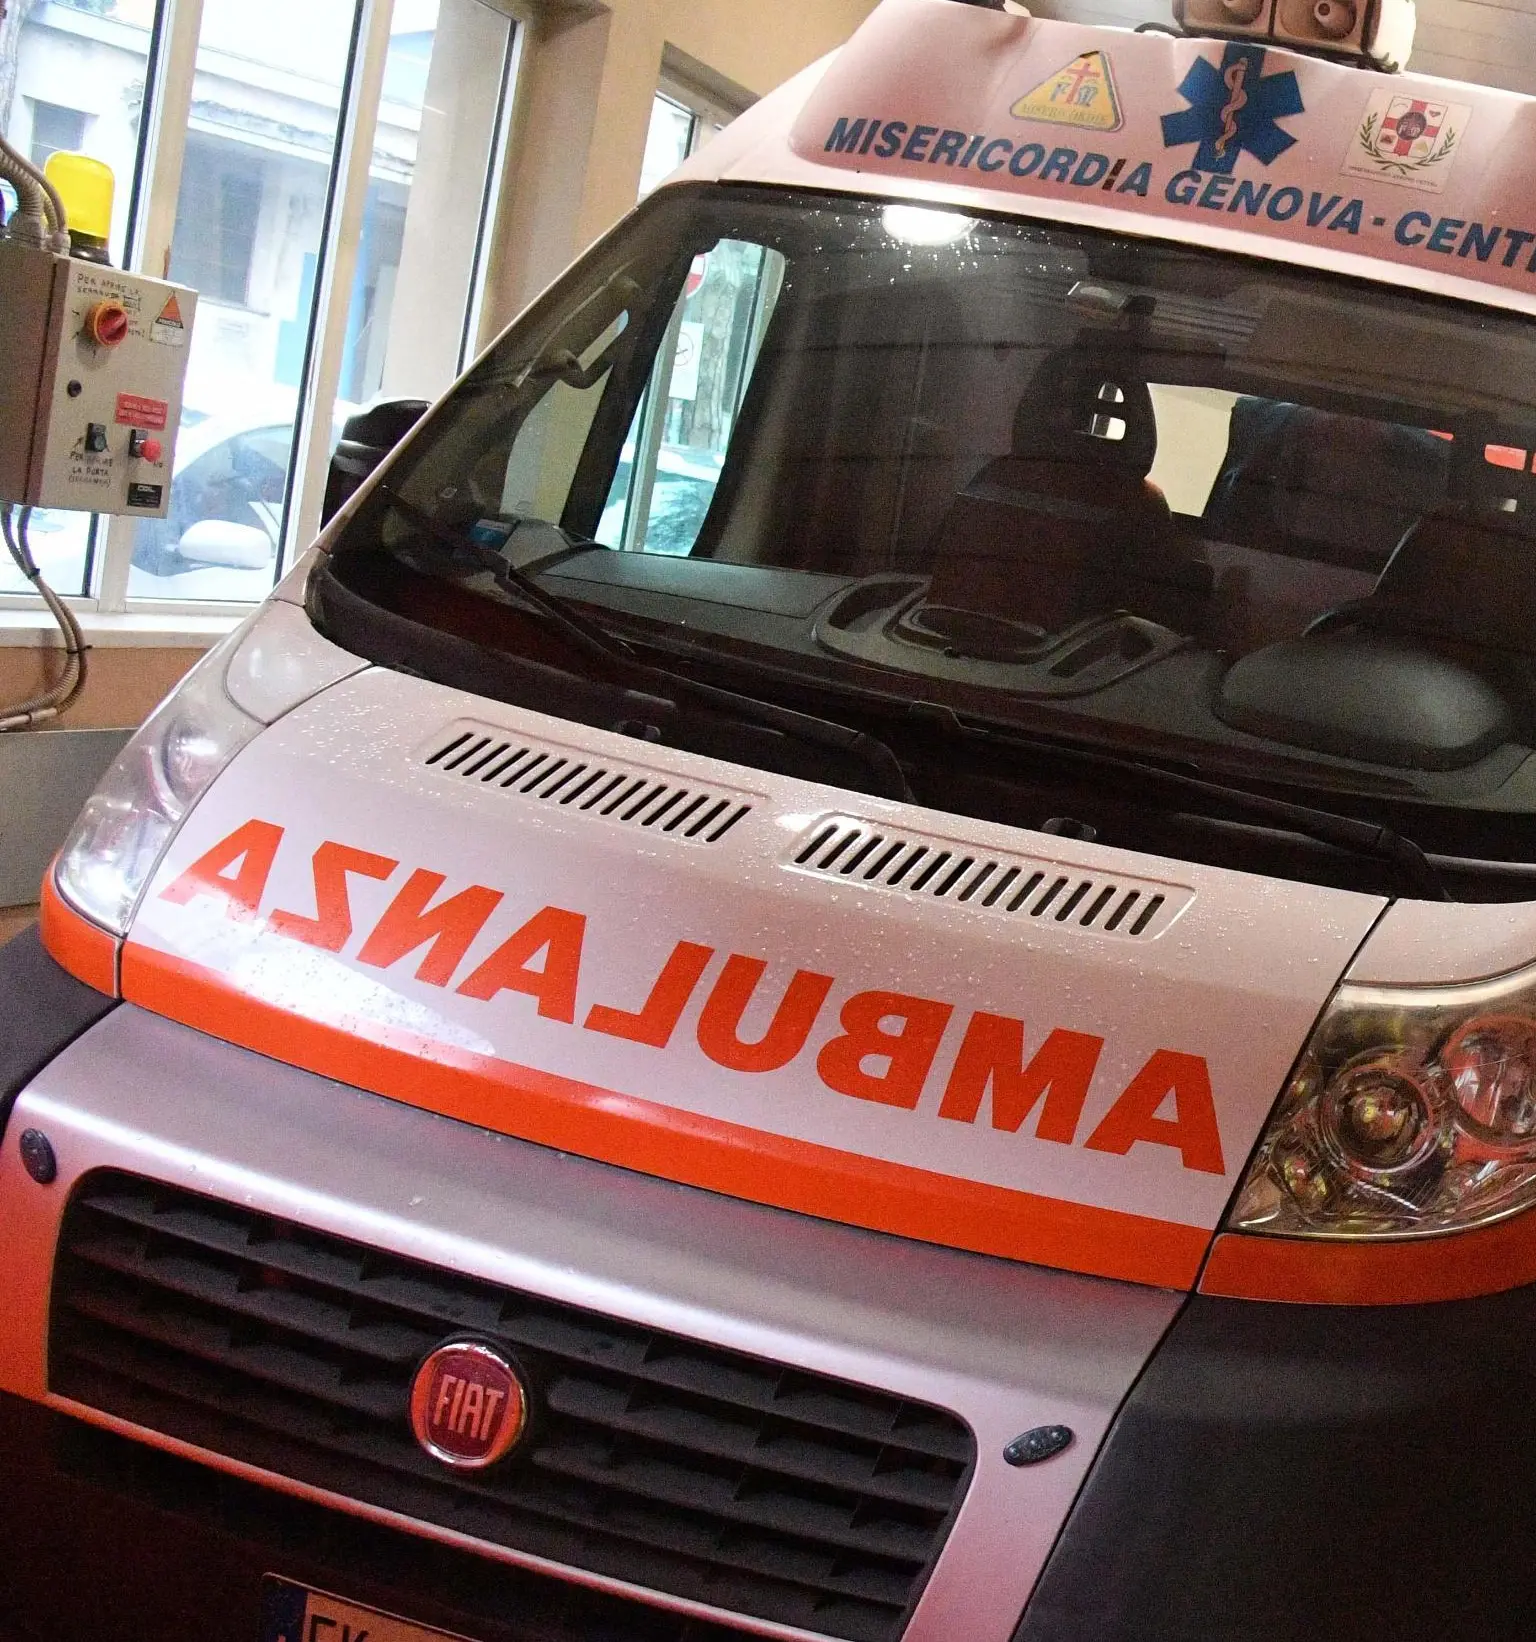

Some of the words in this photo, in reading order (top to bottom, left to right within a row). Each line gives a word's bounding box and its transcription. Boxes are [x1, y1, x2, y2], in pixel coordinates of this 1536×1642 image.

[824, 117, 1153, 197] MISERICORDIA
[1164, 169, 1364, 234] GENOVA
[433, 1374, 505, 1441] FIAT
